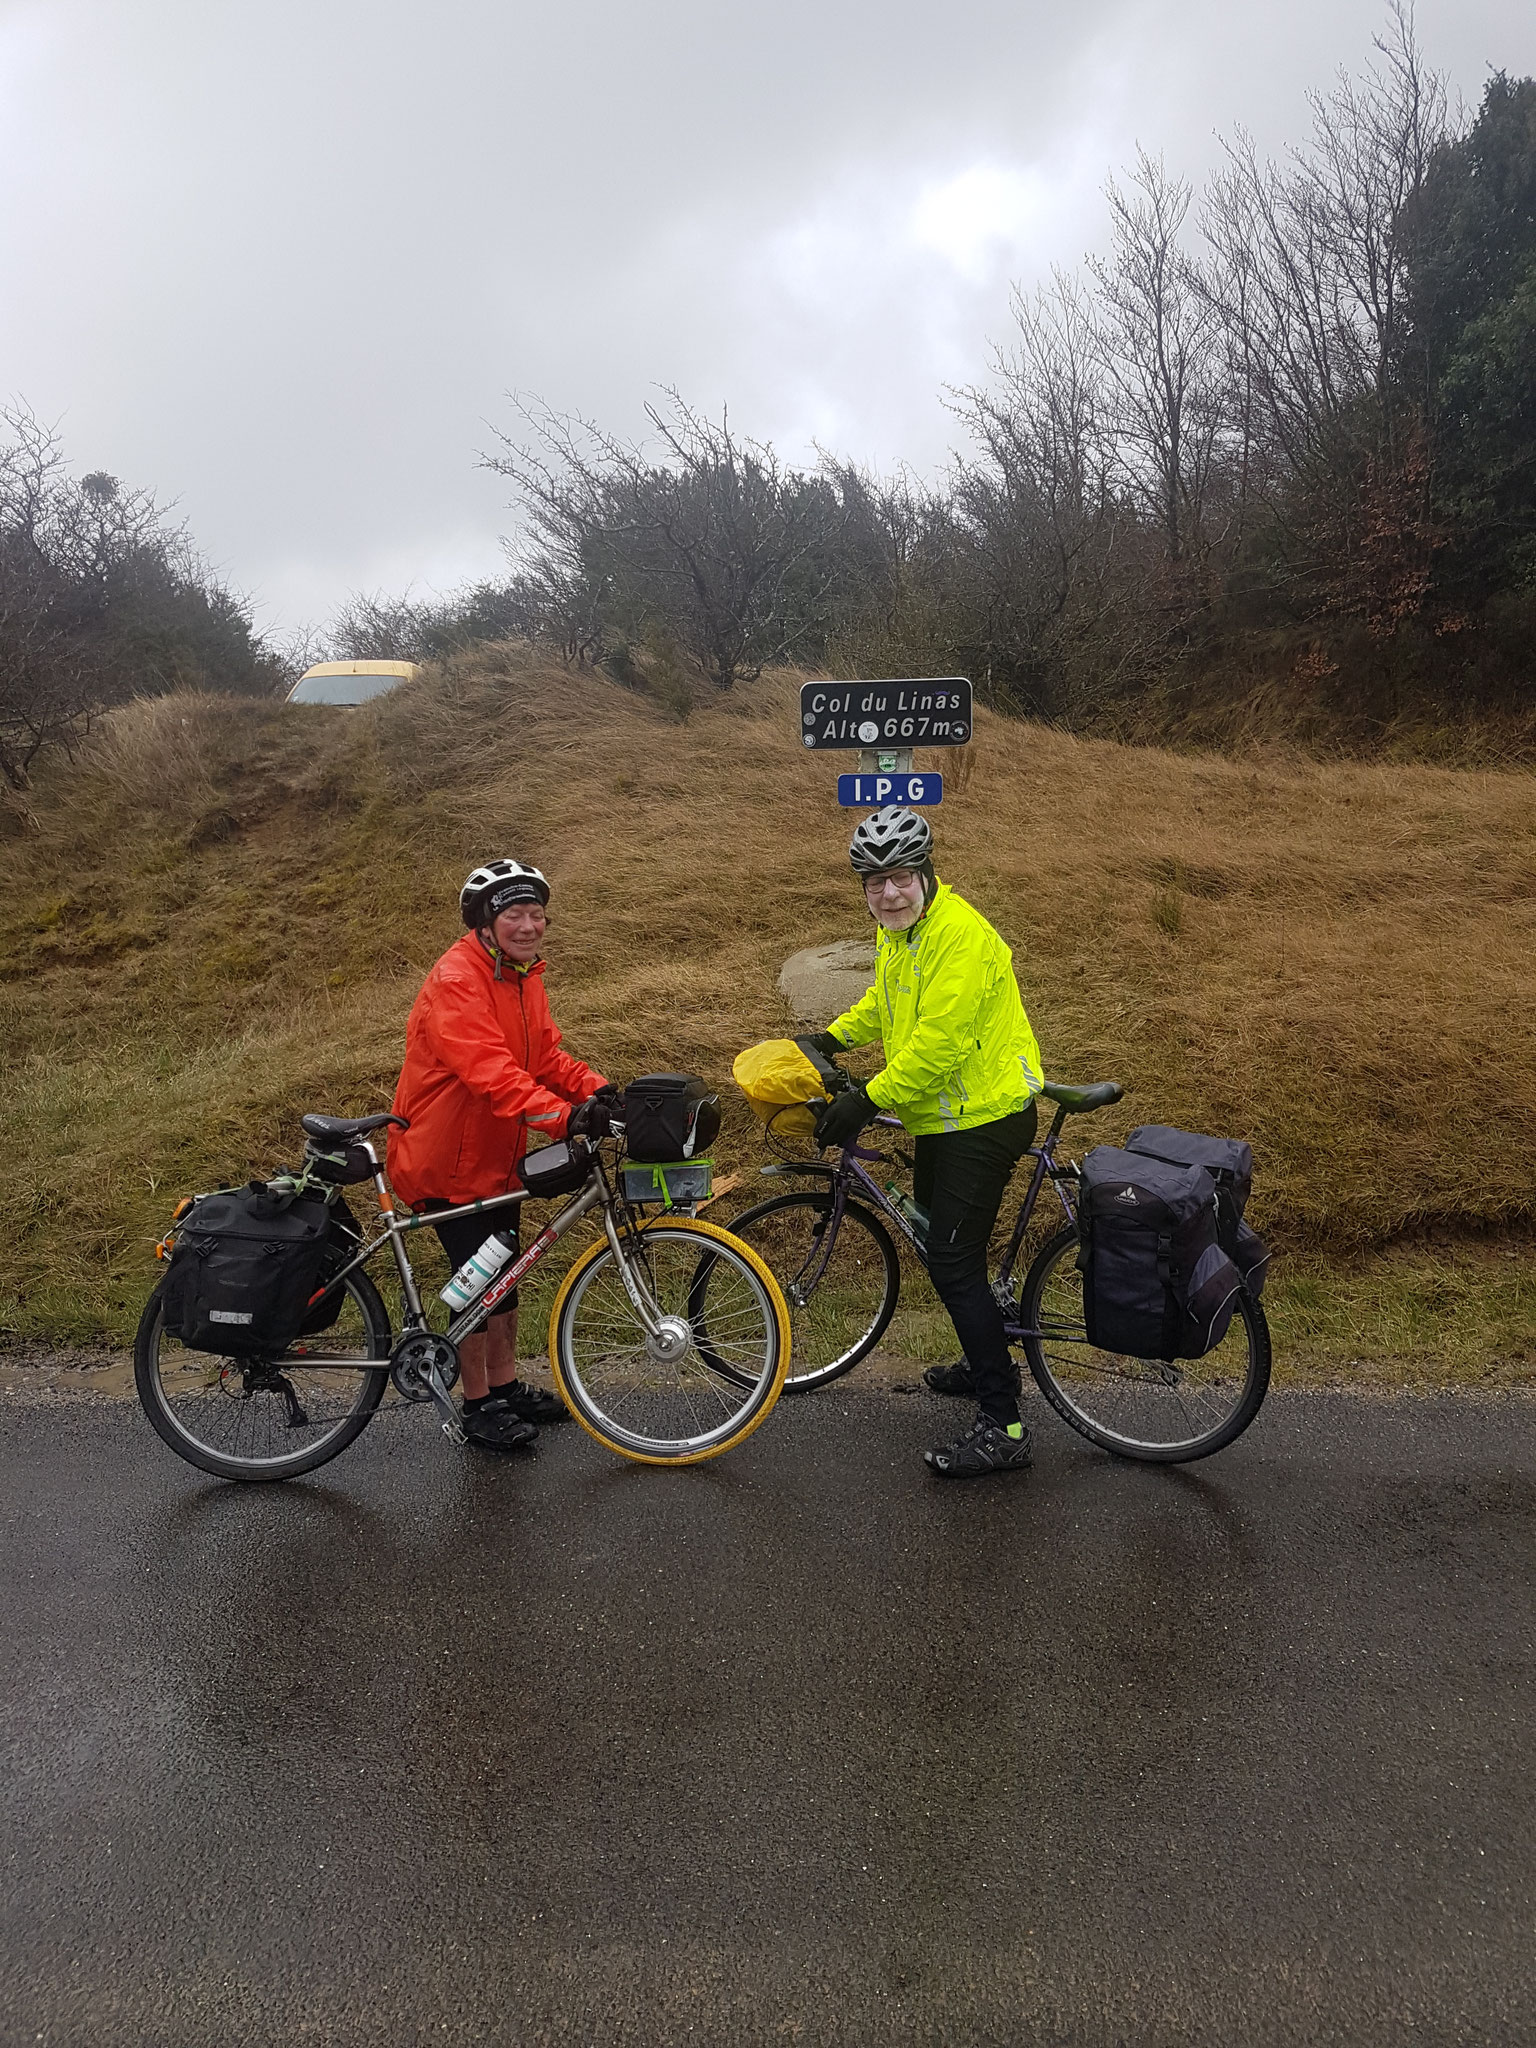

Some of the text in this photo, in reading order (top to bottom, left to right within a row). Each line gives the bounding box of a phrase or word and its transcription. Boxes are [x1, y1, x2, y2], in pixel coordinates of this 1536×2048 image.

[812, 691, 961, 713] Col du Linas
[883, 717, 950, 738] 667m
[854, 778, 925, 802] I.P.G
